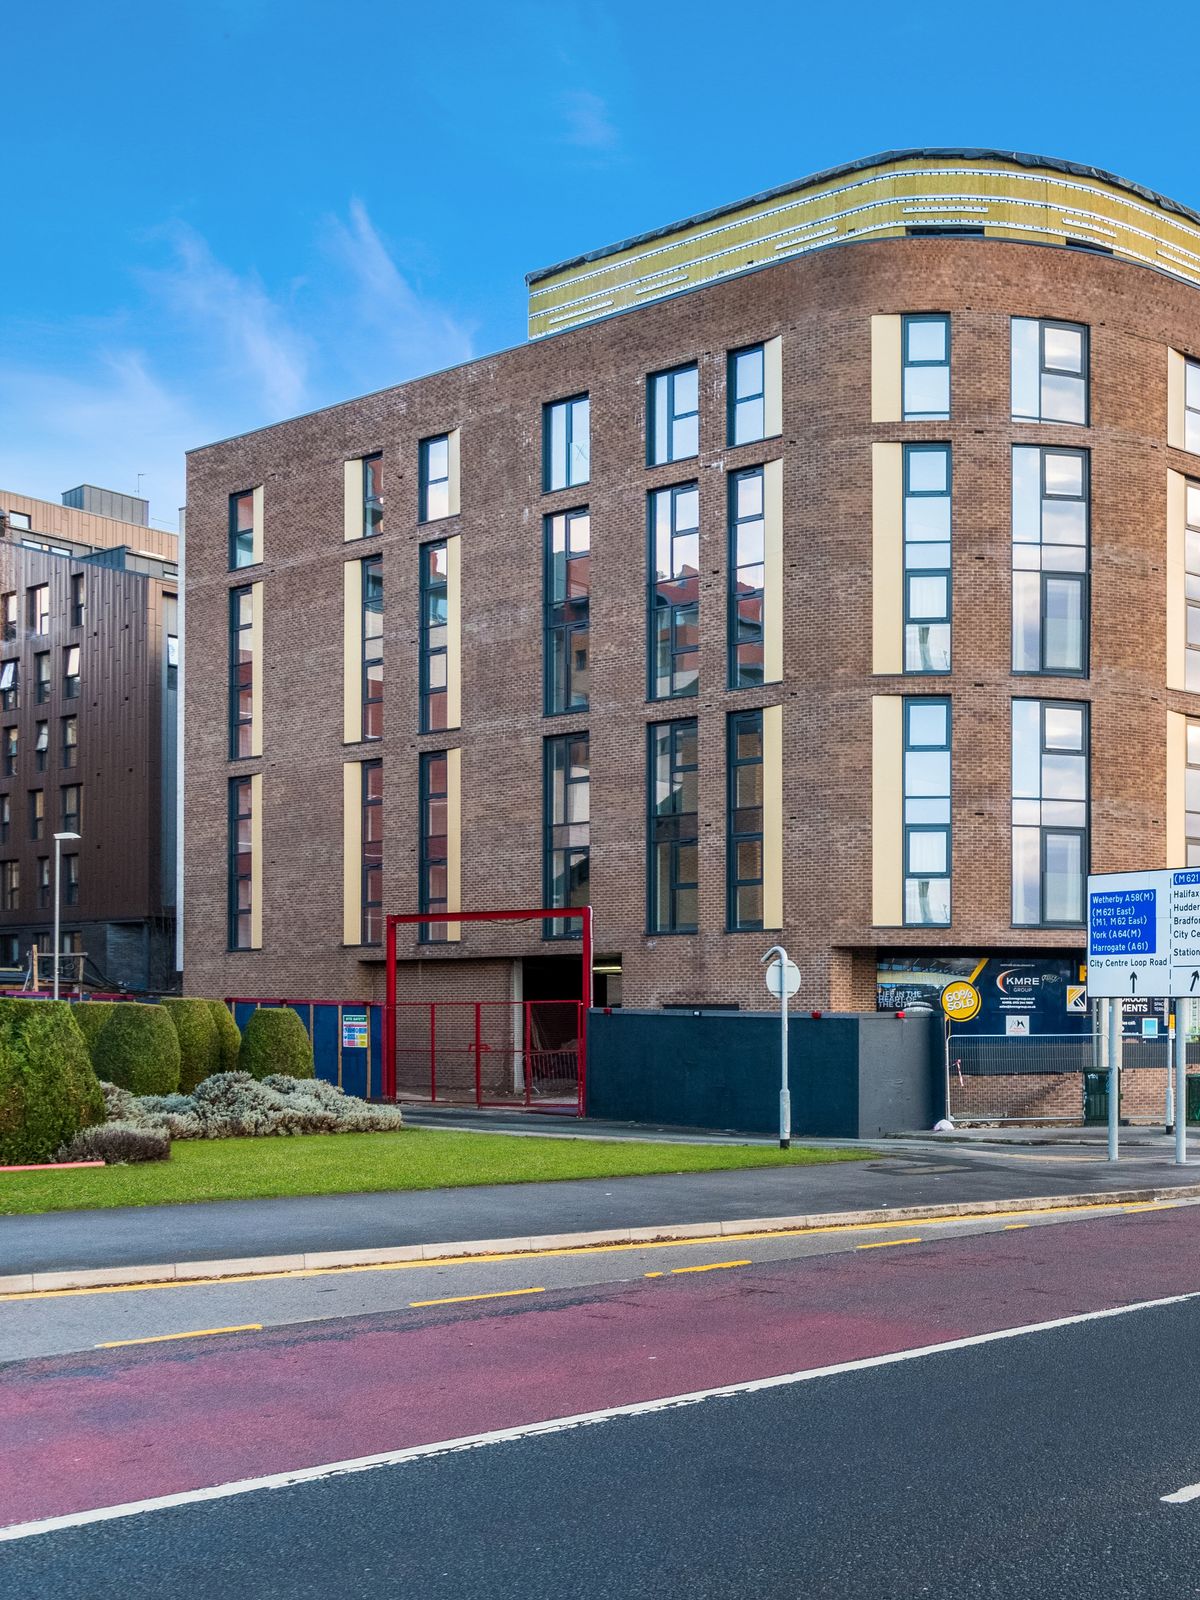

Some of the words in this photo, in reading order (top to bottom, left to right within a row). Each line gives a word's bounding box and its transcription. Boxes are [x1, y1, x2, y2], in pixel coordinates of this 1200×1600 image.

[1174, 874, 1198, 884] (M621
[1174, 890, 1200, 898] Halifax
[1092, 895, 1123, 904] Wetherby
[1092, 908, 1114, 917] (M621
[1116, 906, 1135, 915] East)
[1110, 917, 1126, 925] M62
[1128, 915, 1147, 925] East)
[1174, 930, 1188, 939] City
[1092, 944, 1125, 953] Harrogate
[1128, 941, 1148, 951] (A61)
[1174, 948, 1200, 956] Station
[1090, 960, 1103, 968] City
[1130, 958, 1147, 967] Loop
[946, 990, 972, 1002] 60%
[947, 998, 974, 1011] SOLD
[1122, 1004, 1148, 1012] MENTS
